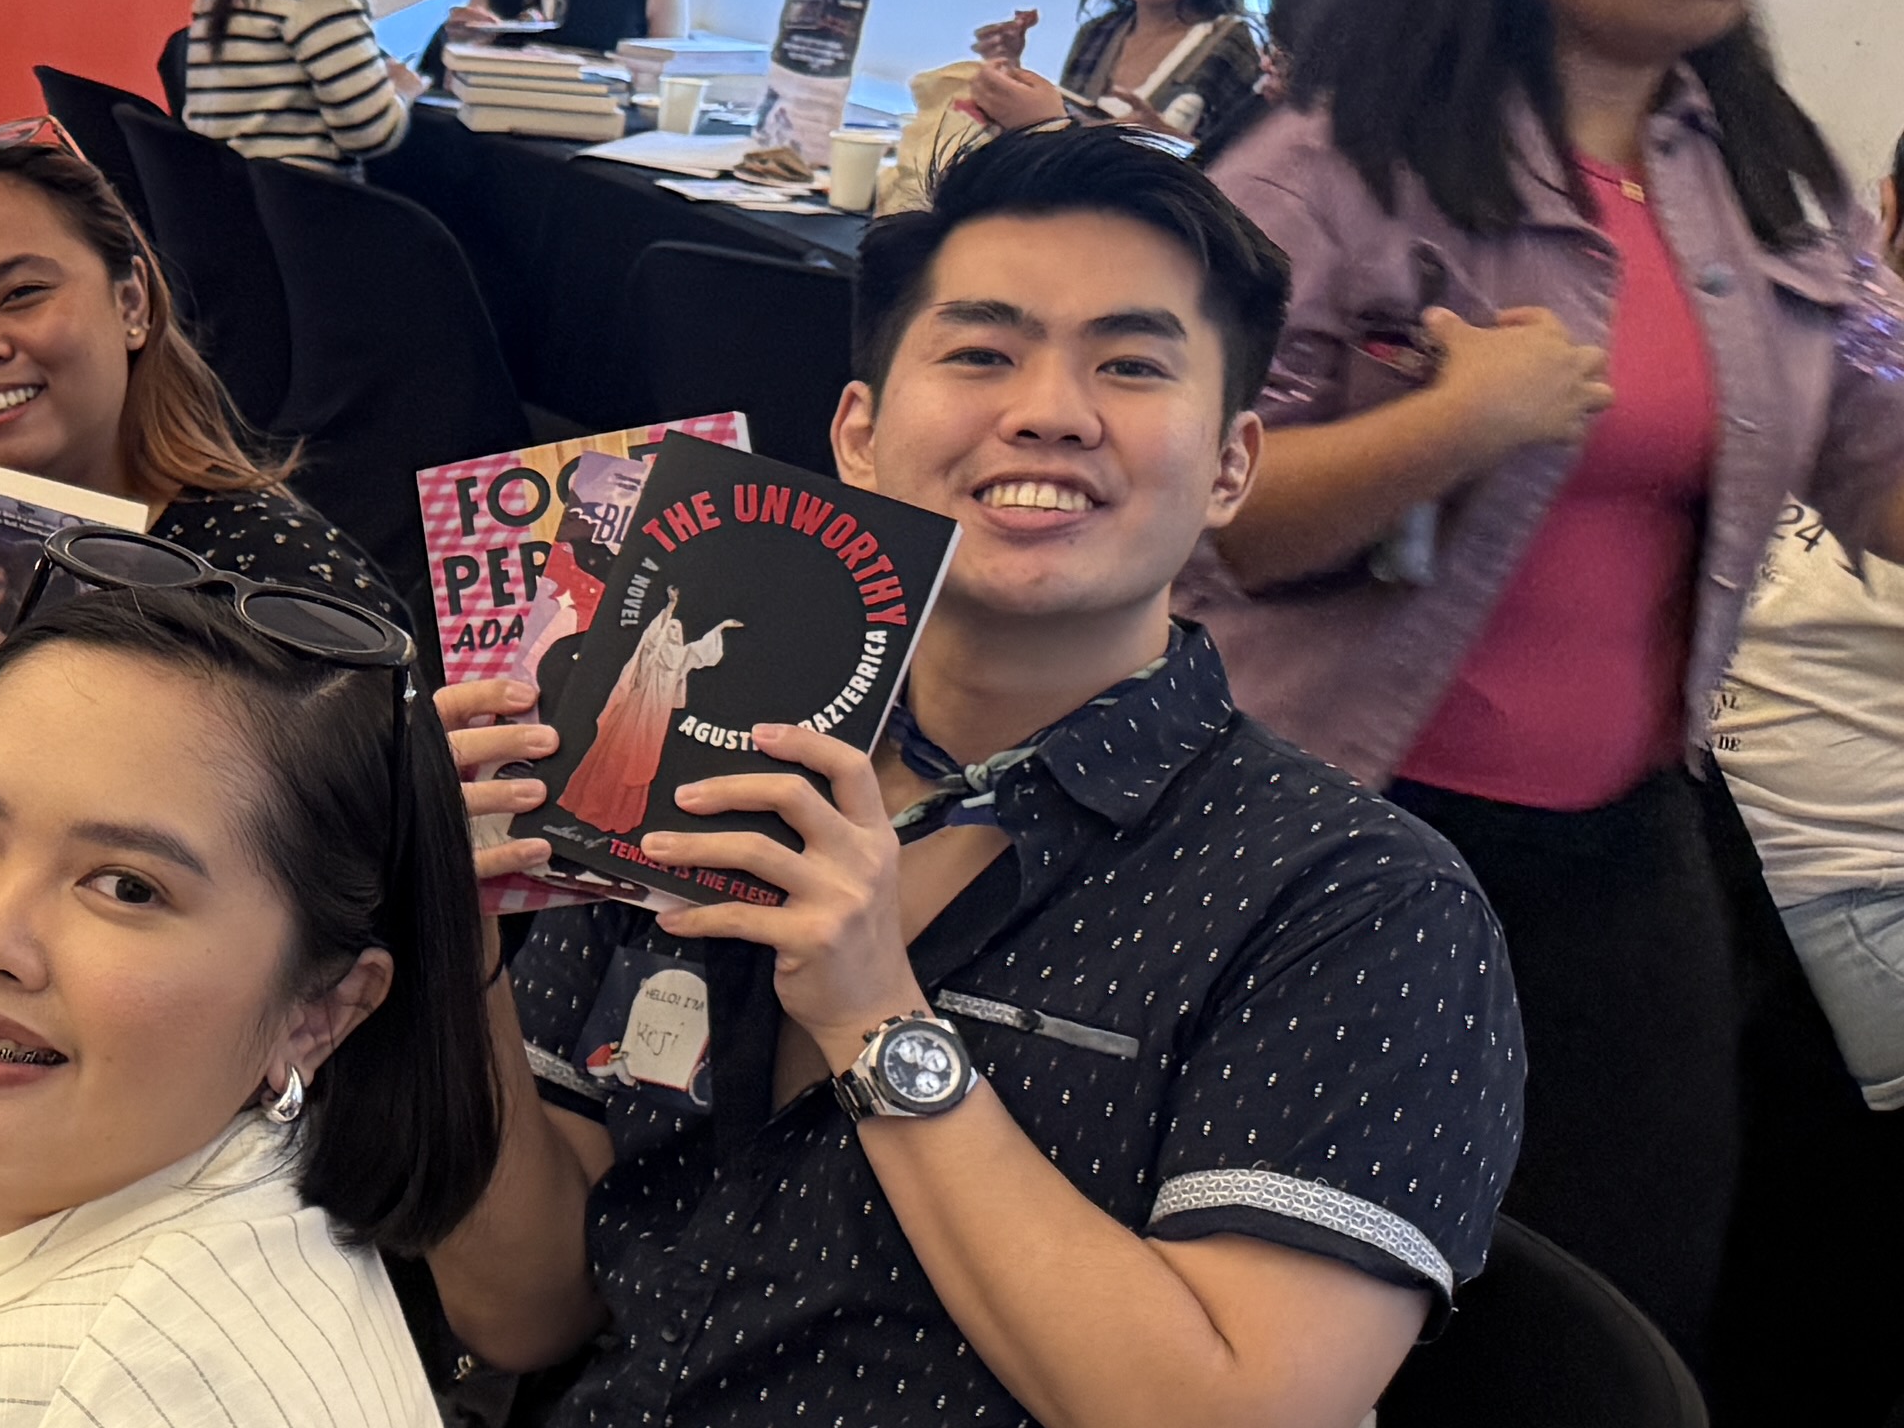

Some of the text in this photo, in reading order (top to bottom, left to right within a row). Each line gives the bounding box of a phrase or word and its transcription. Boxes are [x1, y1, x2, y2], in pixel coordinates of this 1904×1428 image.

[642, 490, 722, 554] THE
[733, 483, 908, 627] UNWORTHY
[620, 556, 660, 627] A NOVEL
[452, 614, 525, 654] ADA
[678, 714, 761, 753] AGUST
[695, 868, 726, 893] THE
[728, 879, 780, 907] FLESH
